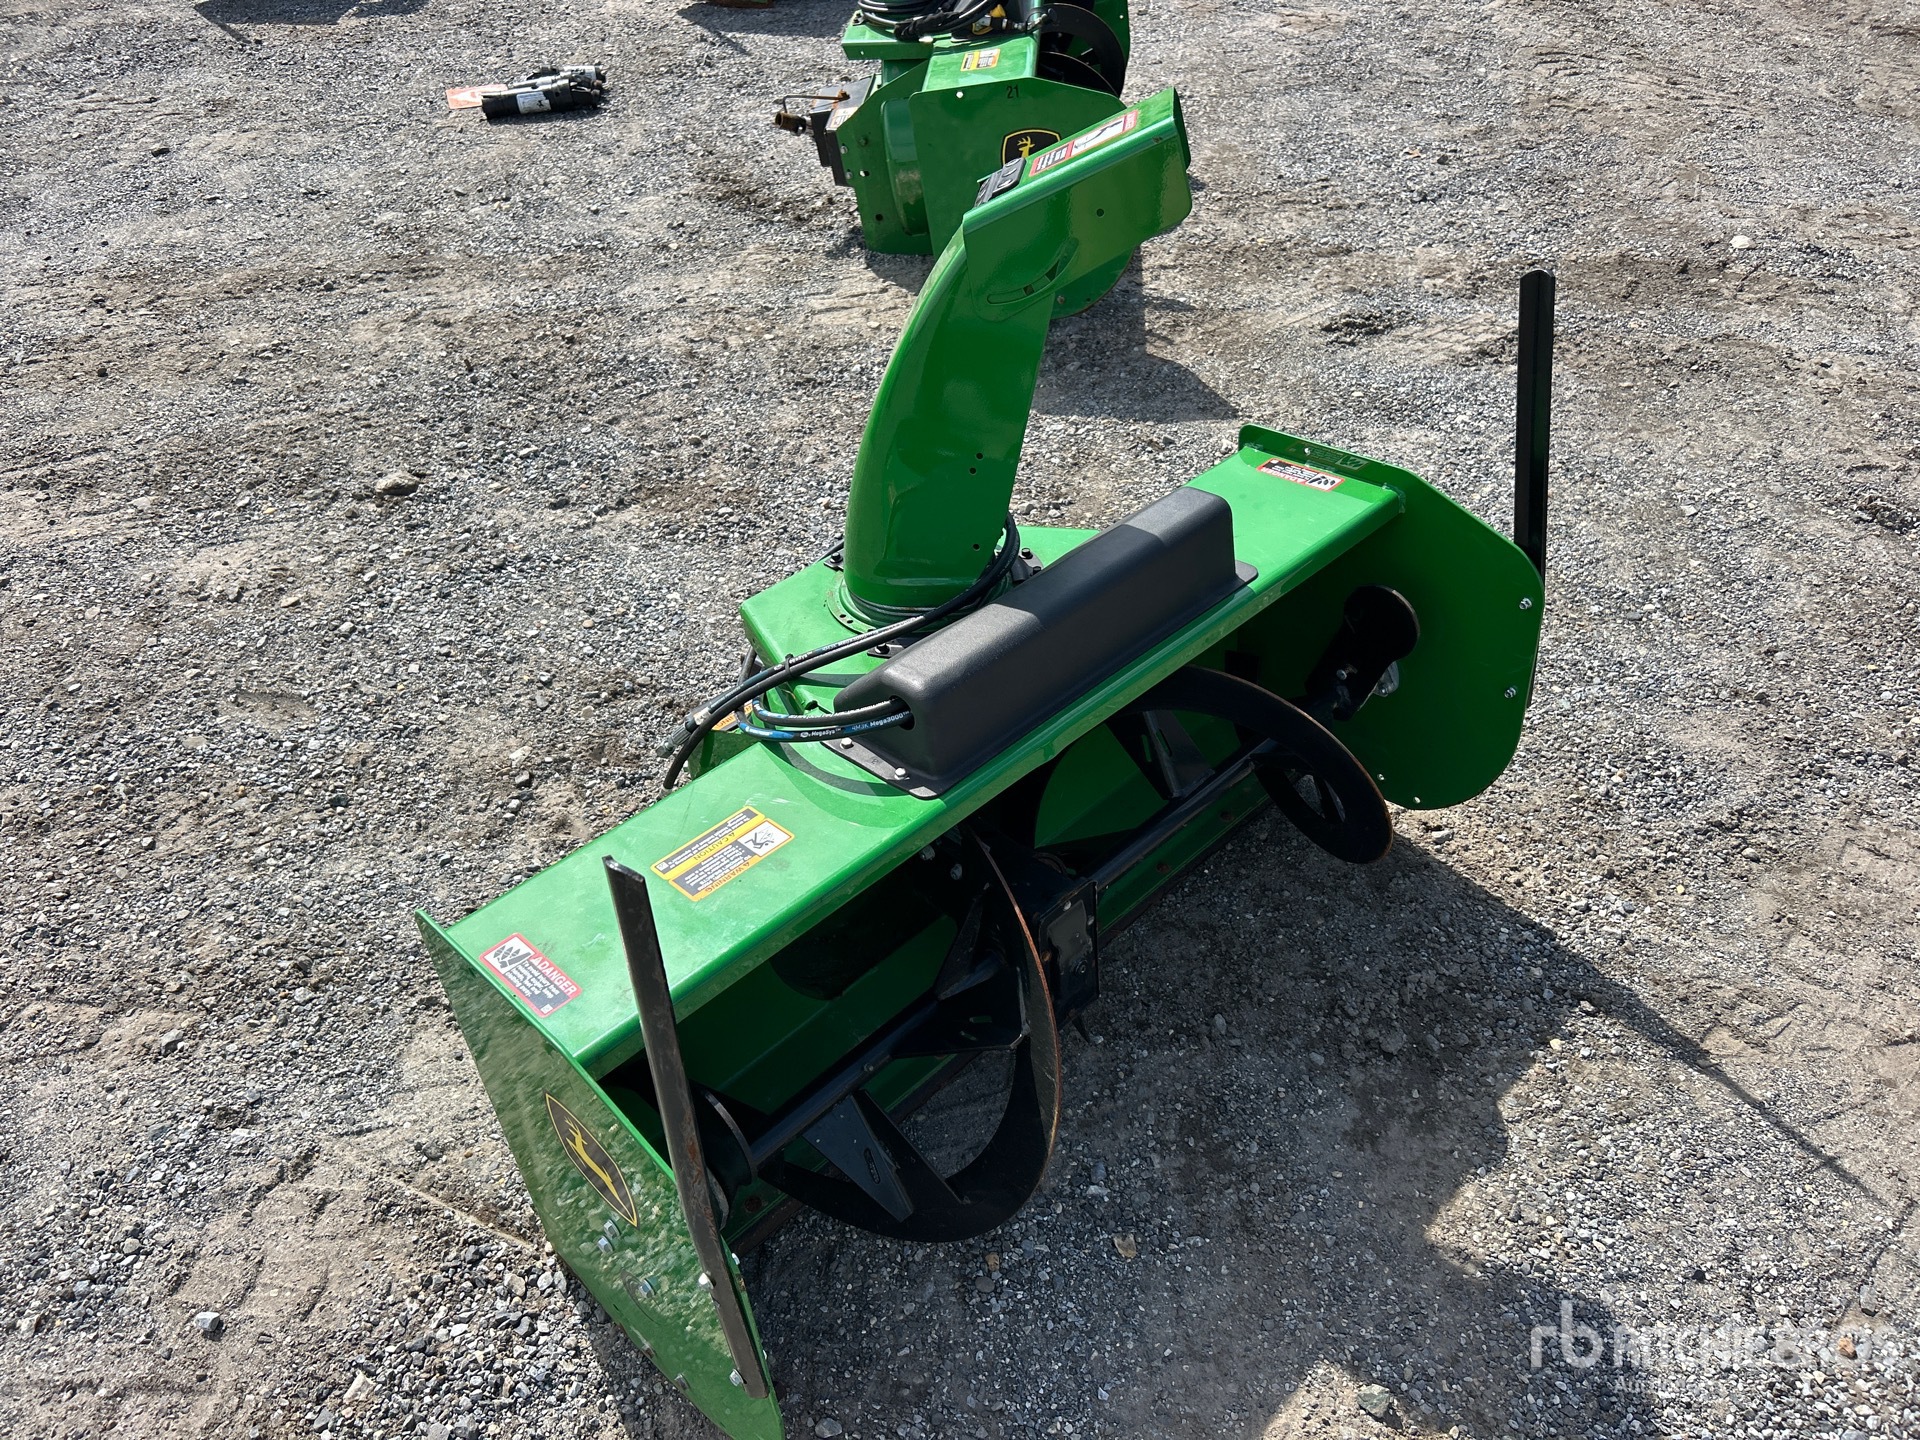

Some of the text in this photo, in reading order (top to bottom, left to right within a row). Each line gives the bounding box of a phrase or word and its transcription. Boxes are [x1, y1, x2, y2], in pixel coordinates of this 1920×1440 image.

[1006, 84, 1019, 99] 21
[692, 836, 729, 860] CAUTION
[703, 865, 744, 893] WARNING
[535, 960, 578, 996] DANGER
